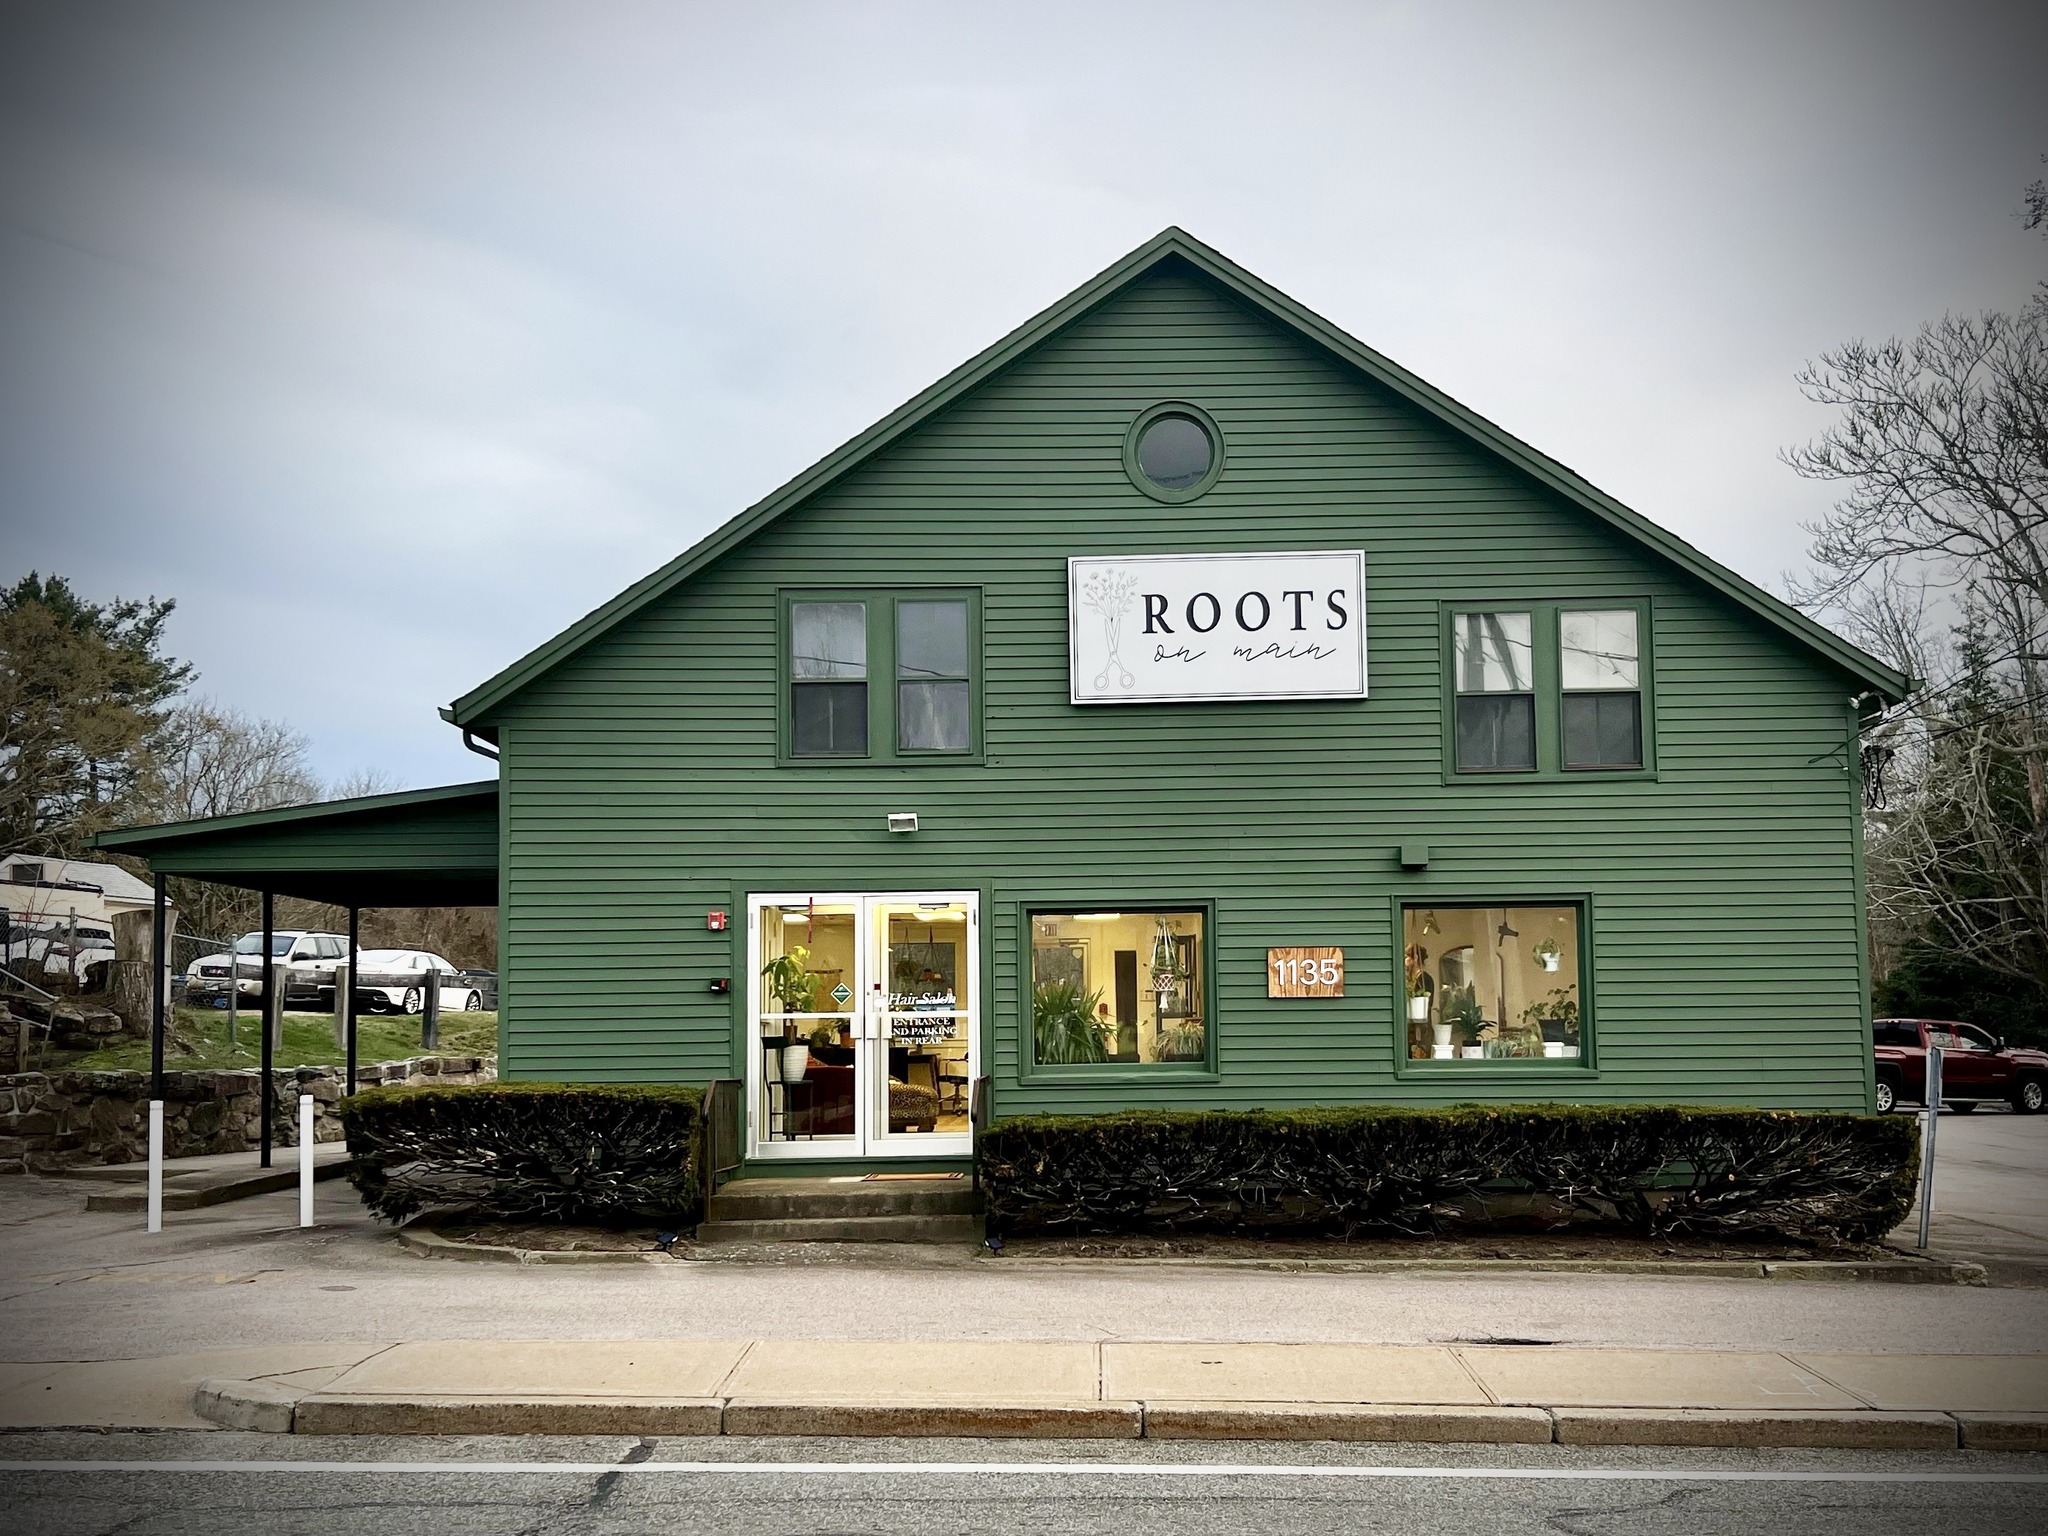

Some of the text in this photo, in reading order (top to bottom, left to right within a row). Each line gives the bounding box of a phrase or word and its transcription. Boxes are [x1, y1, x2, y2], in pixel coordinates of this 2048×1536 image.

[1141, 589, 1348, 635] ROOTS
[1154, 641, 1337, 663] on main
[1274, 959, 1338, 986] 1135
[888, 992, 918, 1005] Hair
[893, 1017, 951, 1026] ENTRANCE
[890, 1026, 957, 1036] ND PARKING
[901, 1036, 943, 1045] IN REAR
